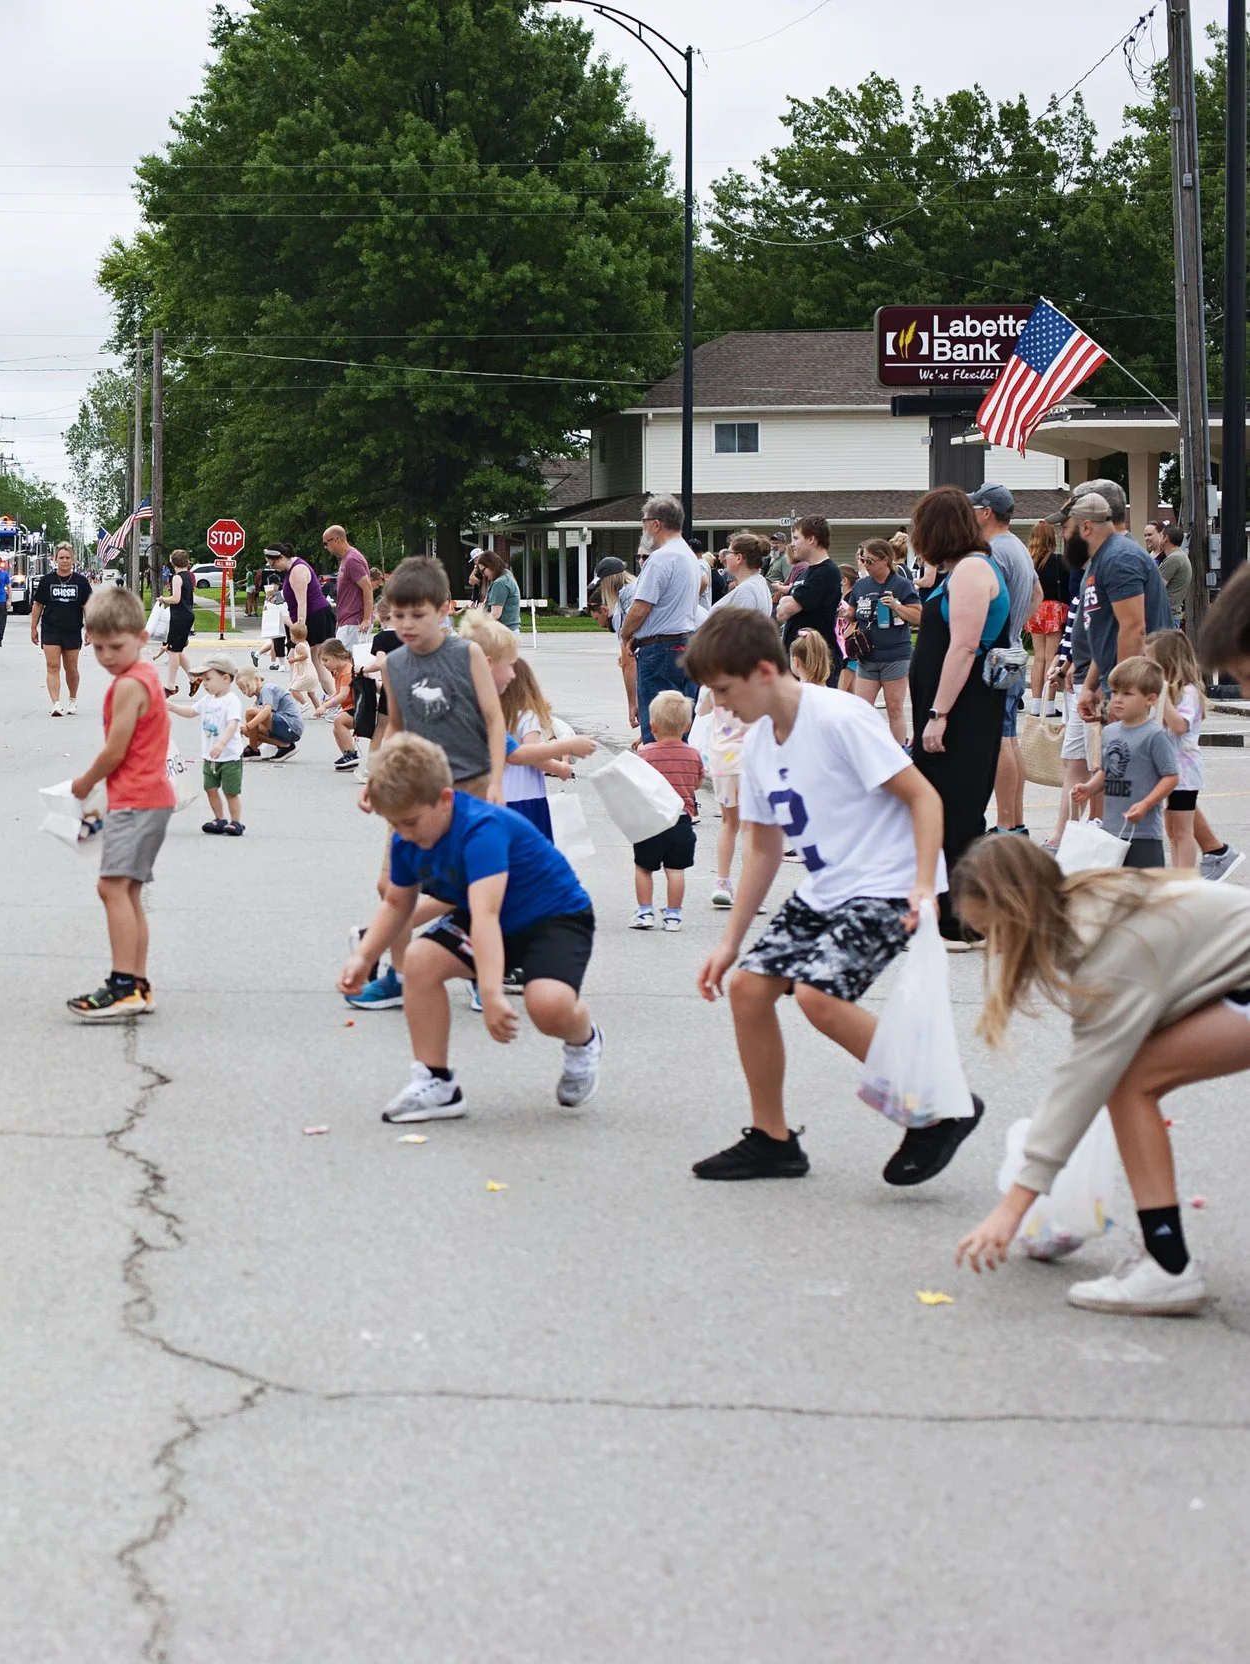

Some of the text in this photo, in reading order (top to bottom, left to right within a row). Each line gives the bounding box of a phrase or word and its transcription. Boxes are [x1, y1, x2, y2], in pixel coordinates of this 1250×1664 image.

[933, 315, 1028, 337] Labette
[933, 339, 1001, 361] Bank
[919, 368, 999, 381] We're Flexible!
[210, 530, 243, 546] STOP
[52, 587, 76, 597] CHEER
